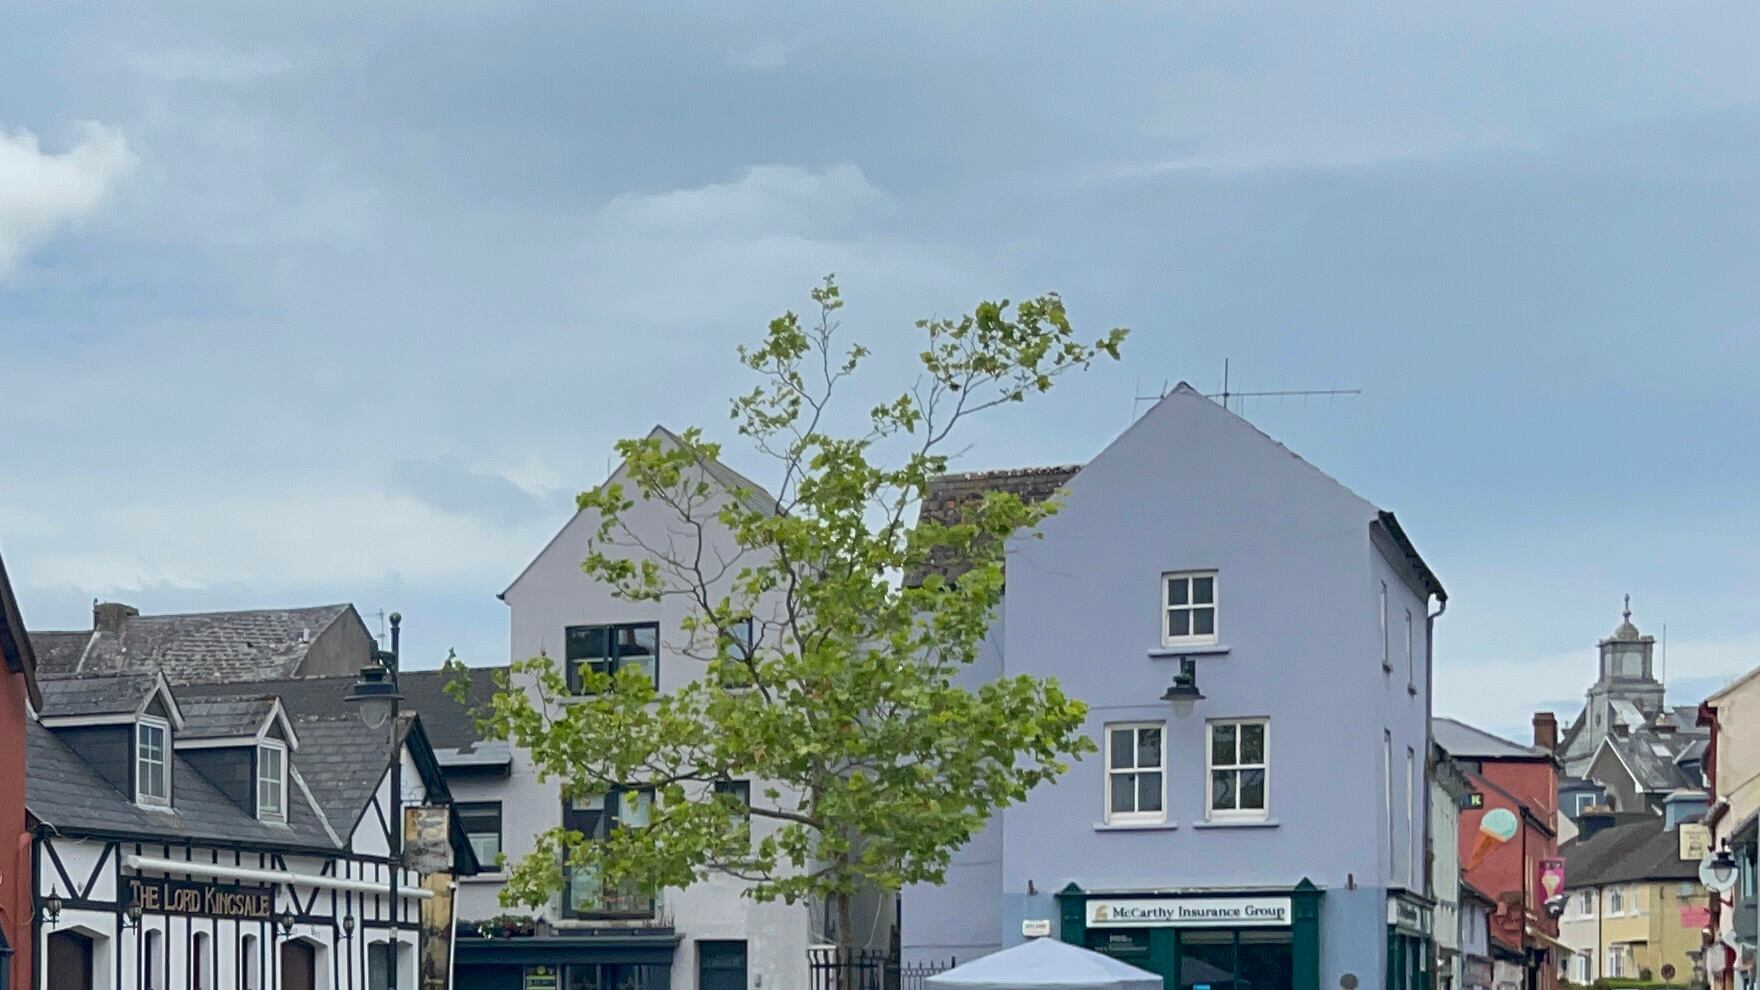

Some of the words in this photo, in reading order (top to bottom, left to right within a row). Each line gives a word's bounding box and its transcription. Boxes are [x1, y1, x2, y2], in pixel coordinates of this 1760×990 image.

[129, 879, 160, 910] THE
[164, 883, 201, 912] LORD
[205, 886, 271, 917] KINGSALE
[1113, 905, 1174, 921] McCarthy
[1179, 905, 1240, 918] Insurance
[1244, 904, 1285, 920] Group
